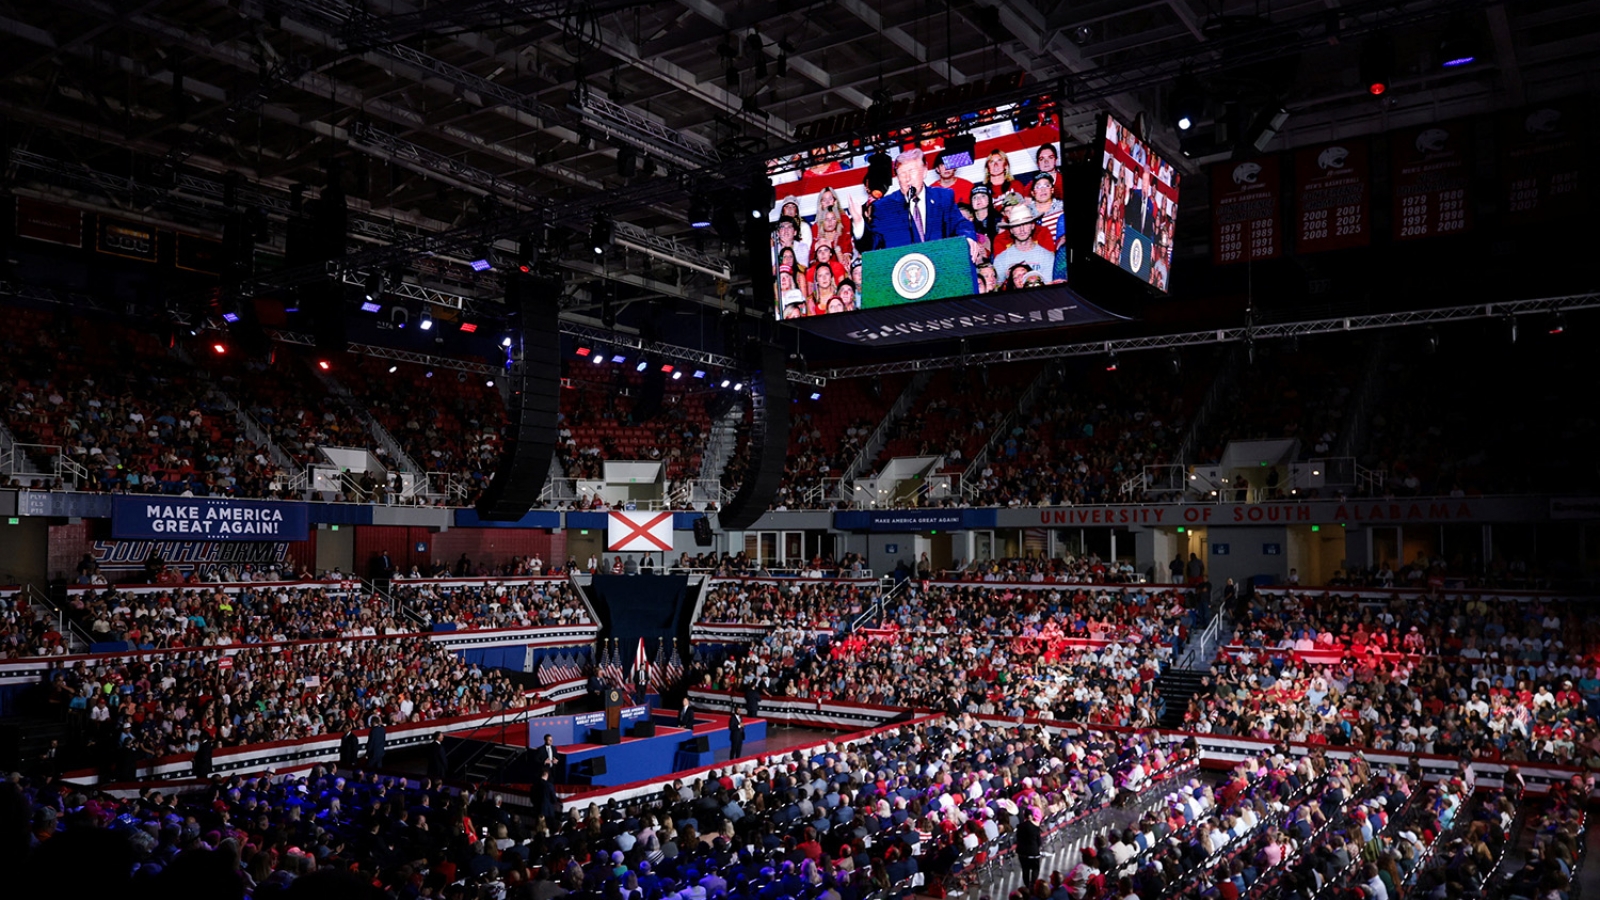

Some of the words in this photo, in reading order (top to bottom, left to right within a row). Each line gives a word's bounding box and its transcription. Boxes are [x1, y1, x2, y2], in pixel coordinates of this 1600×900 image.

[1402, 195, 1427, 206] 1979
[1438, 189, 1464, 202] 1980
[1302, 209, 1328, 221] 2000
[1336, 205, 1361, 216] 2001
[1402, 205, 1427, 217] 1989
[1439, 200, 1464, 212] 1991
[1220, 223, 1241, 234] 1979
[1251, 218, 1273, 229] 1980
[1302, 219, 1327, 231] 2006
[1336, 214, 1361, 226] 2007
[1403, 216, 1427, 226] 1997
[1439, 210, 1464, 222] 1998
[1220, 233, 1241, 243] 1981
[1252, 228, 1273, 238] 1989
[1302, 229, 1328, 240] 2008
[1336, 224, 1361, 236] 2025
[1400, 225, 1427, 236] 2006
[1437, 220, 1465, 232] 2008
[1220, 242, 1242, 252] 1990
[1252, 237, 1273, 248] 1991
[1221, 251, 1242, 261] 1997
[1252, 246, 1274, 257] 1998
[147, 506, 198, 518] MAKE
[206, 507, 283, 521] AMERICA
[1040, 509, 1164, 524] UNIVERSITY
[1184, 508, 1211, 522] OF
[1233, 506, 1310, 522] SOUTH
[1335, 502, 1472, 520] ALABAMA
[152, 520, 212, 532] GREAT
[219, 521, 278, 534] AGAIN!
